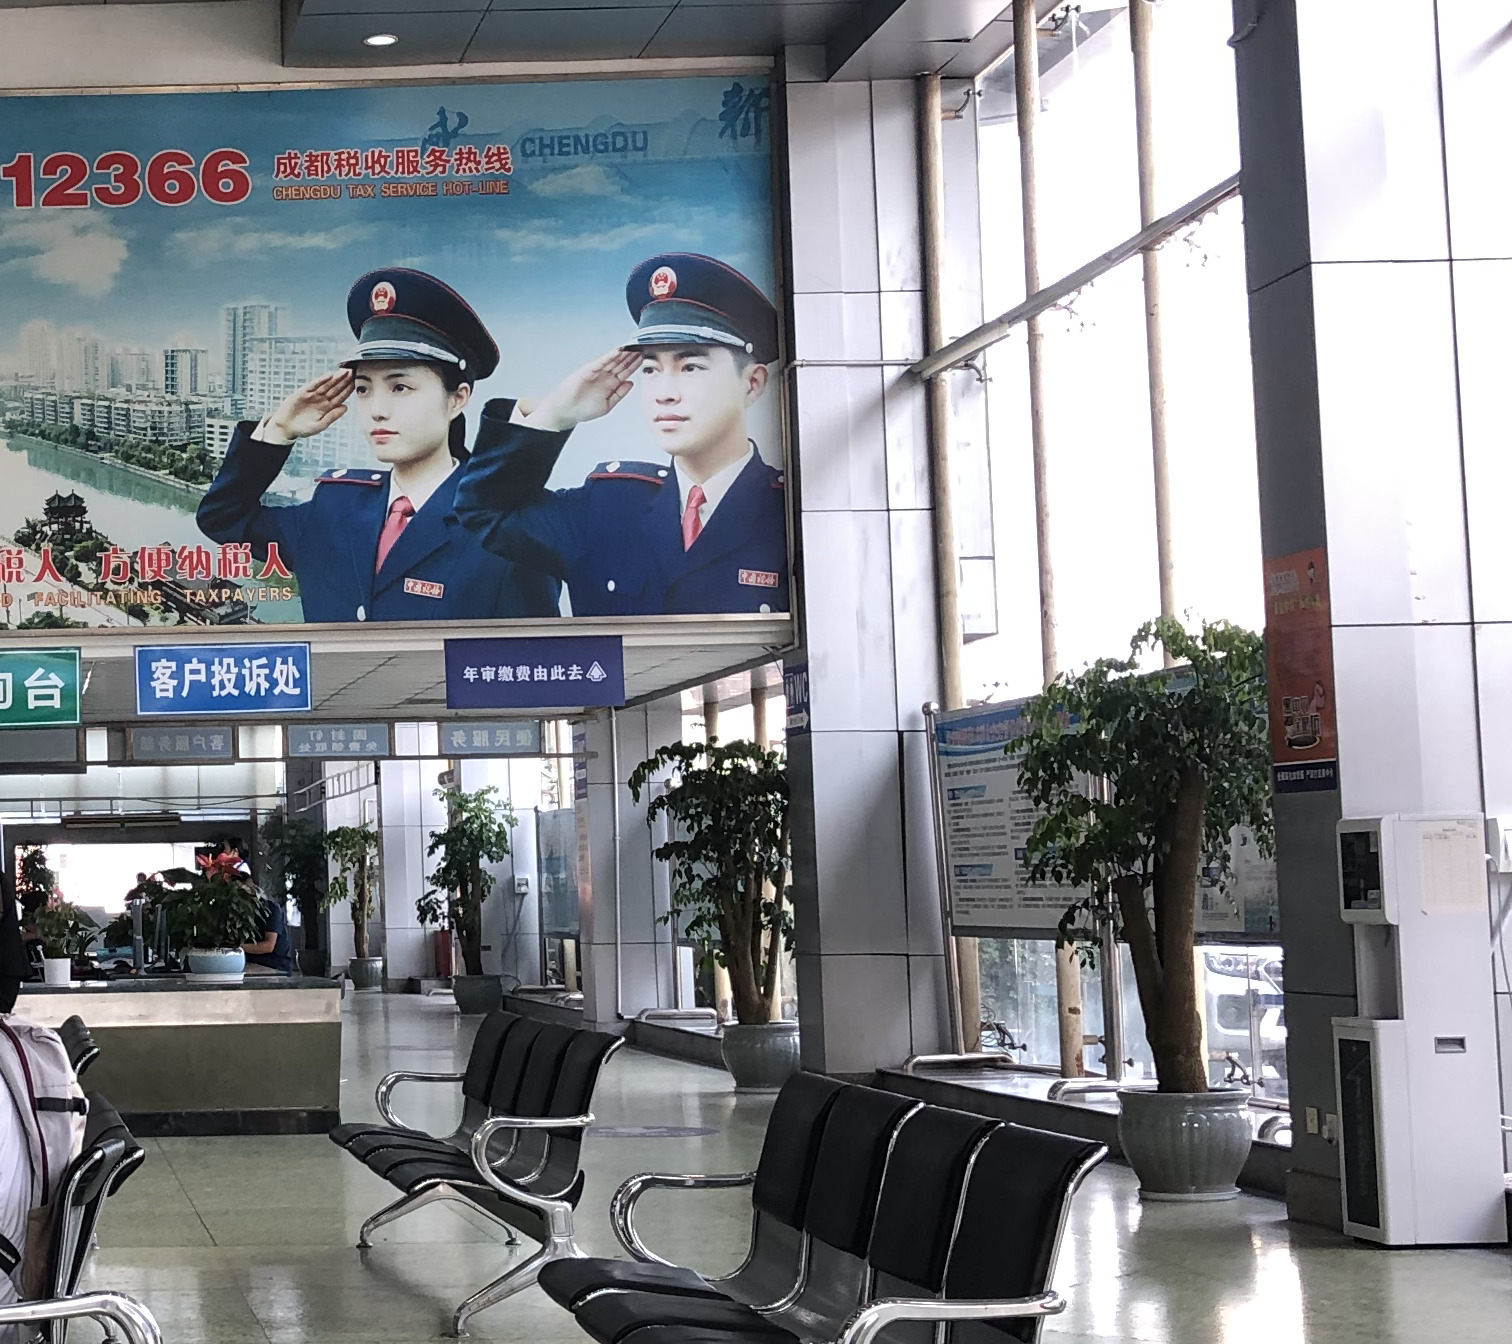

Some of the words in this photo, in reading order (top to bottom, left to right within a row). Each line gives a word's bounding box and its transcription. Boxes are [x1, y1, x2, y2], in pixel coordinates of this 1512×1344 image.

[520, 131, 649, 158] CHENGDU
[273, 146, 513, 179] 成都税收服务热线
[1, 149, 251, 207] 12366
[273, 186, 341, 200] CHENGDU
[346, 184, 375, 198] TAX
[381, 182, 437, 197] SERVICE
[443, 180, 509, 196] HOT-LINE
[97, 542, 292, 583] 方便纳税人
[34, 590, 162, 607] FACILITATING
[184, 587, 293, 603] TAXPAYERS
[150, 656, 301, 699] 客户投诉处
[463, 664, 584, 683] 年审缴费由此去
